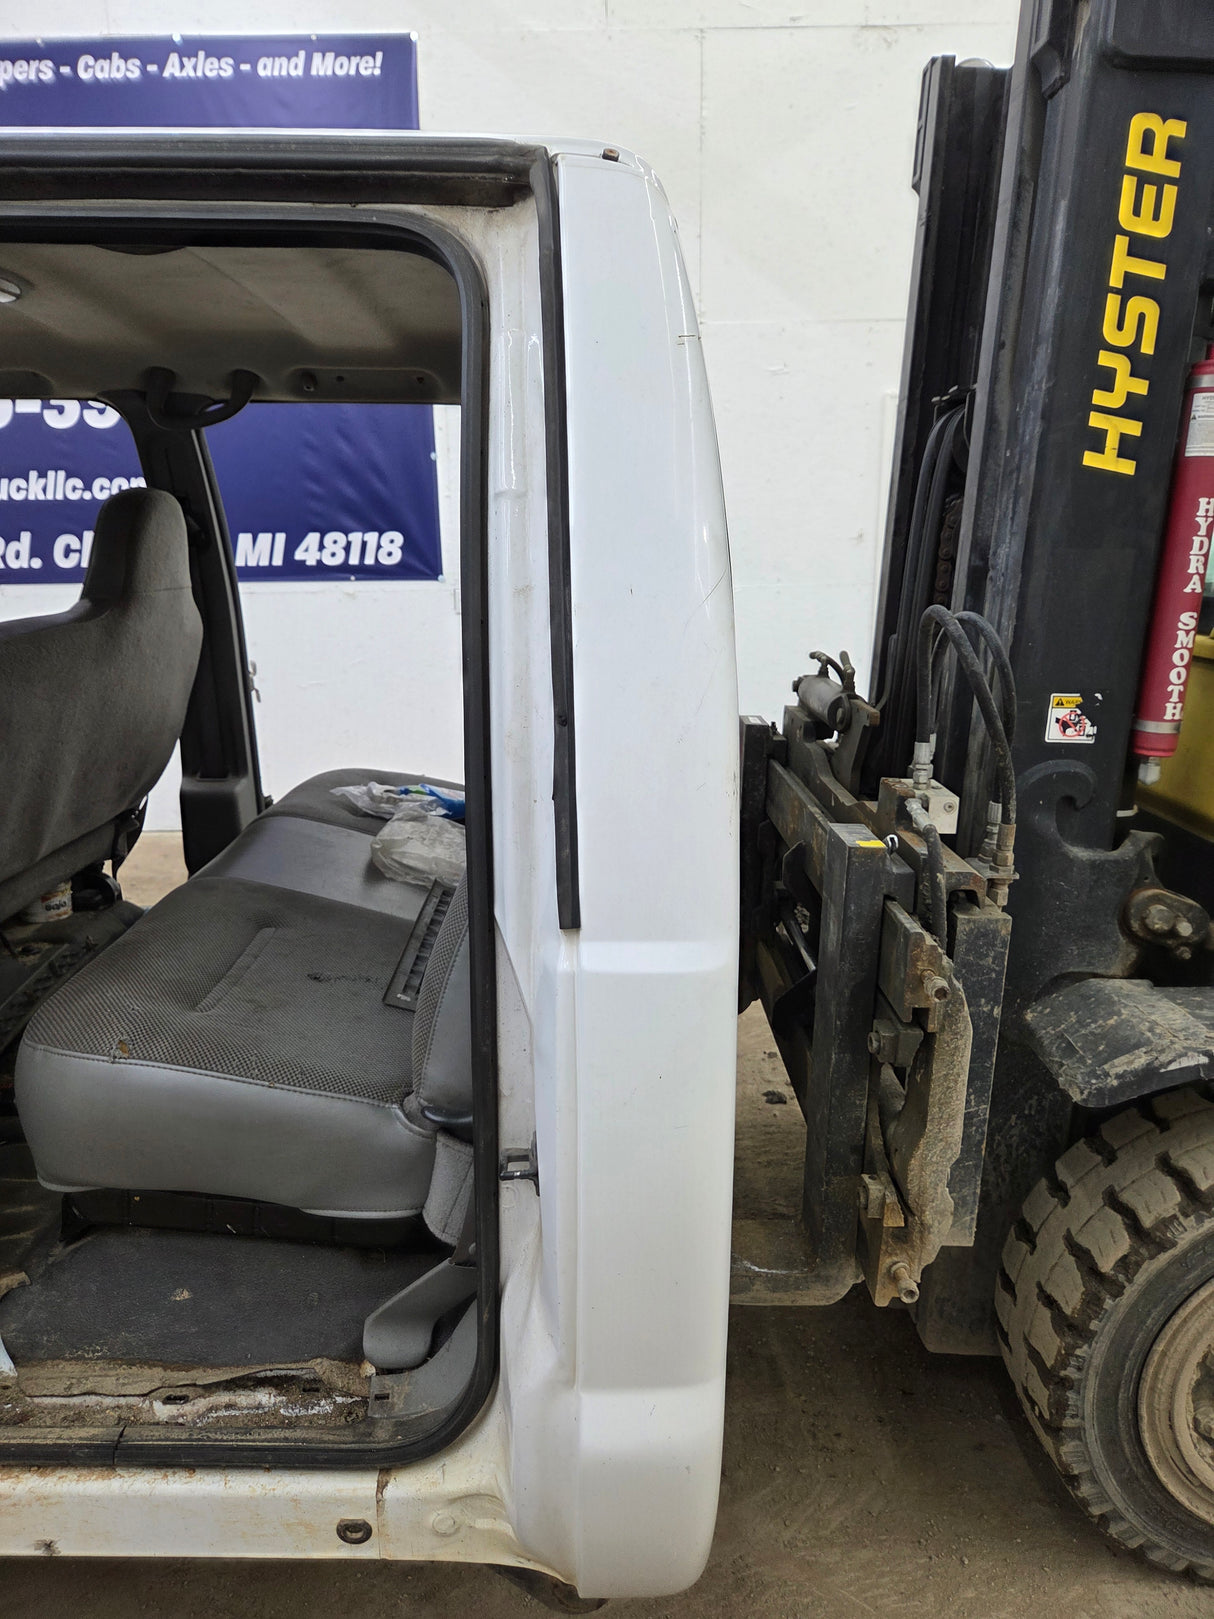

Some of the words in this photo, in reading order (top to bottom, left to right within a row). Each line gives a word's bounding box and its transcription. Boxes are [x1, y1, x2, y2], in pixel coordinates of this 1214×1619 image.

[77, 52, 142, 80] Cabs
[163, 51, 234, 78] Axles
[257, 50, 306, 77] and
[310, 51, 383, 76] More!
[1082, 112, 1187, 475] HYSTER
[235, 532, 286, 567] MI
[294, 531, 404, 566] 48118
[1183, 498, 1214, 593] HYDRA
[1163, 612, 1198, 720] SMOOTH
